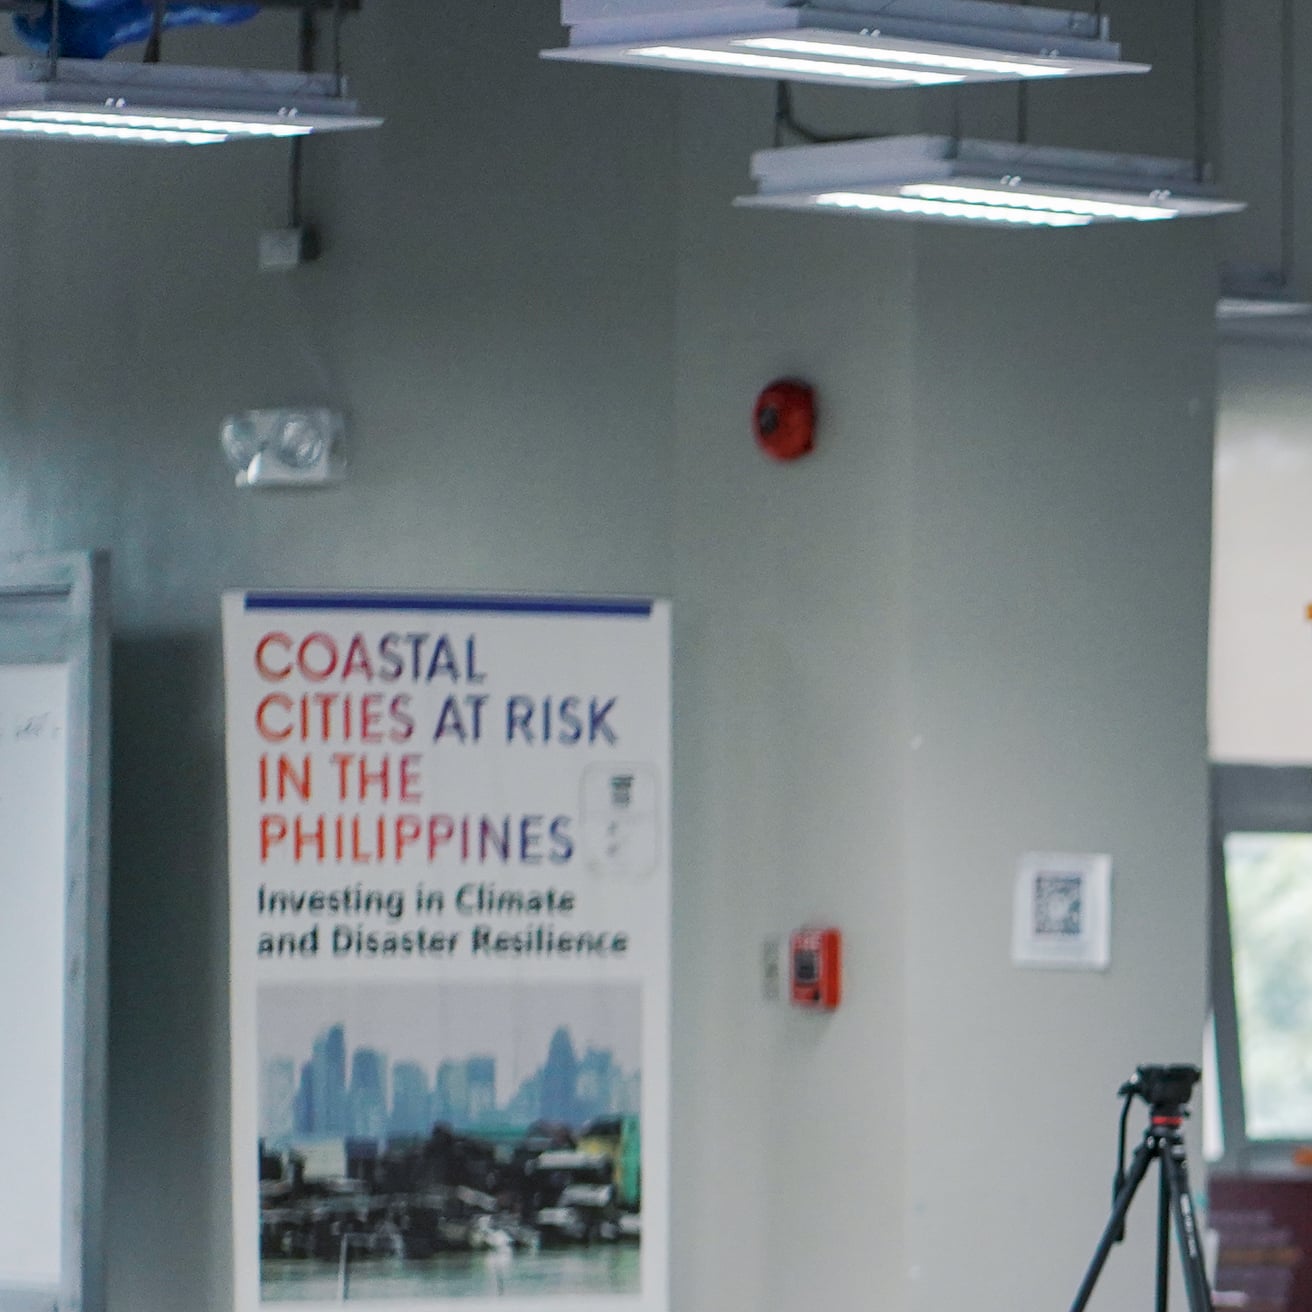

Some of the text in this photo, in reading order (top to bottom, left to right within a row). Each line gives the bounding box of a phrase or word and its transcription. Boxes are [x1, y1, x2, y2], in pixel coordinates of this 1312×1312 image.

[255, 631, 488, 685] COASTAL
[255, 691, 619, 745] CITIES AT RISK
[258, 752, 424, 803] IN THE
[259, 812, 575, 864] PHILIPPINES
[257, 883, 576, 918] Investing in Climate
[256, 925, 630, 957] and Disaster Resilience
